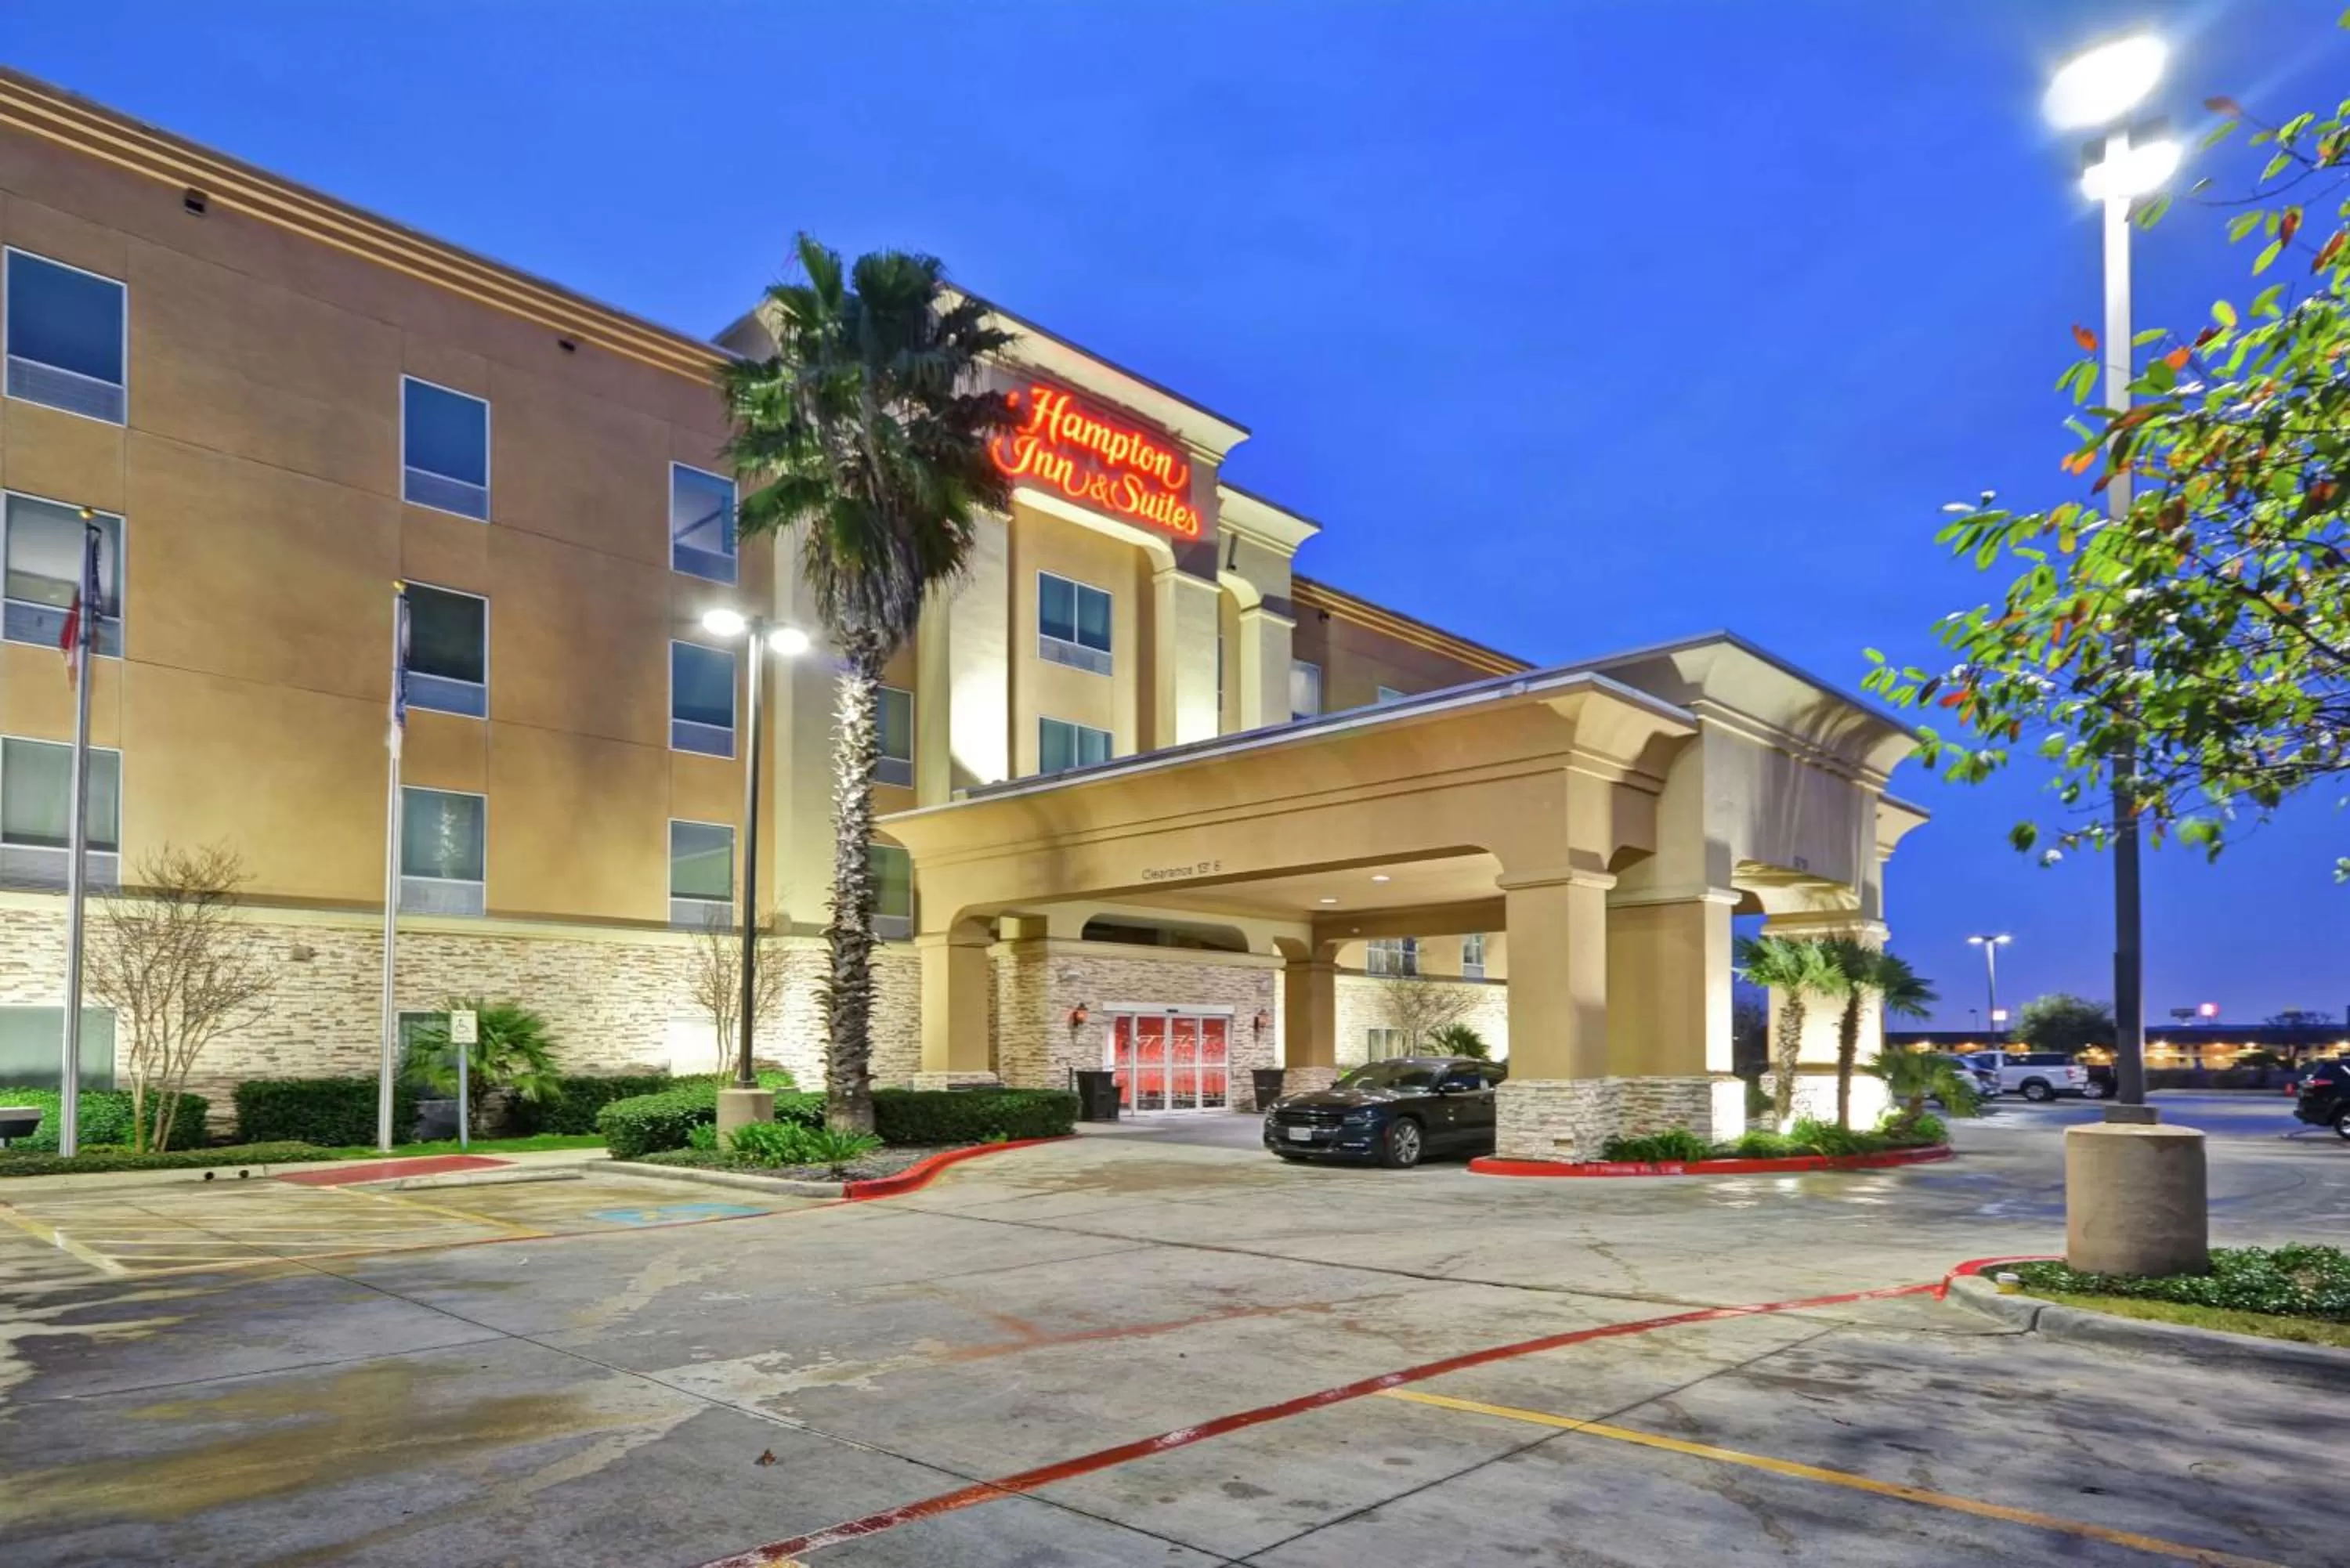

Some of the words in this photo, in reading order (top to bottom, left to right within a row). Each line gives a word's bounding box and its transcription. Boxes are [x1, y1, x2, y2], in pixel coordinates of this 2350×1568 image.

[991, 435, 1091, 497] Inn
[1090, 473, 1113, 509] &
[1111, 473, 1198, 537] Suites
[1007, 386, 1188, 490] Hampton
